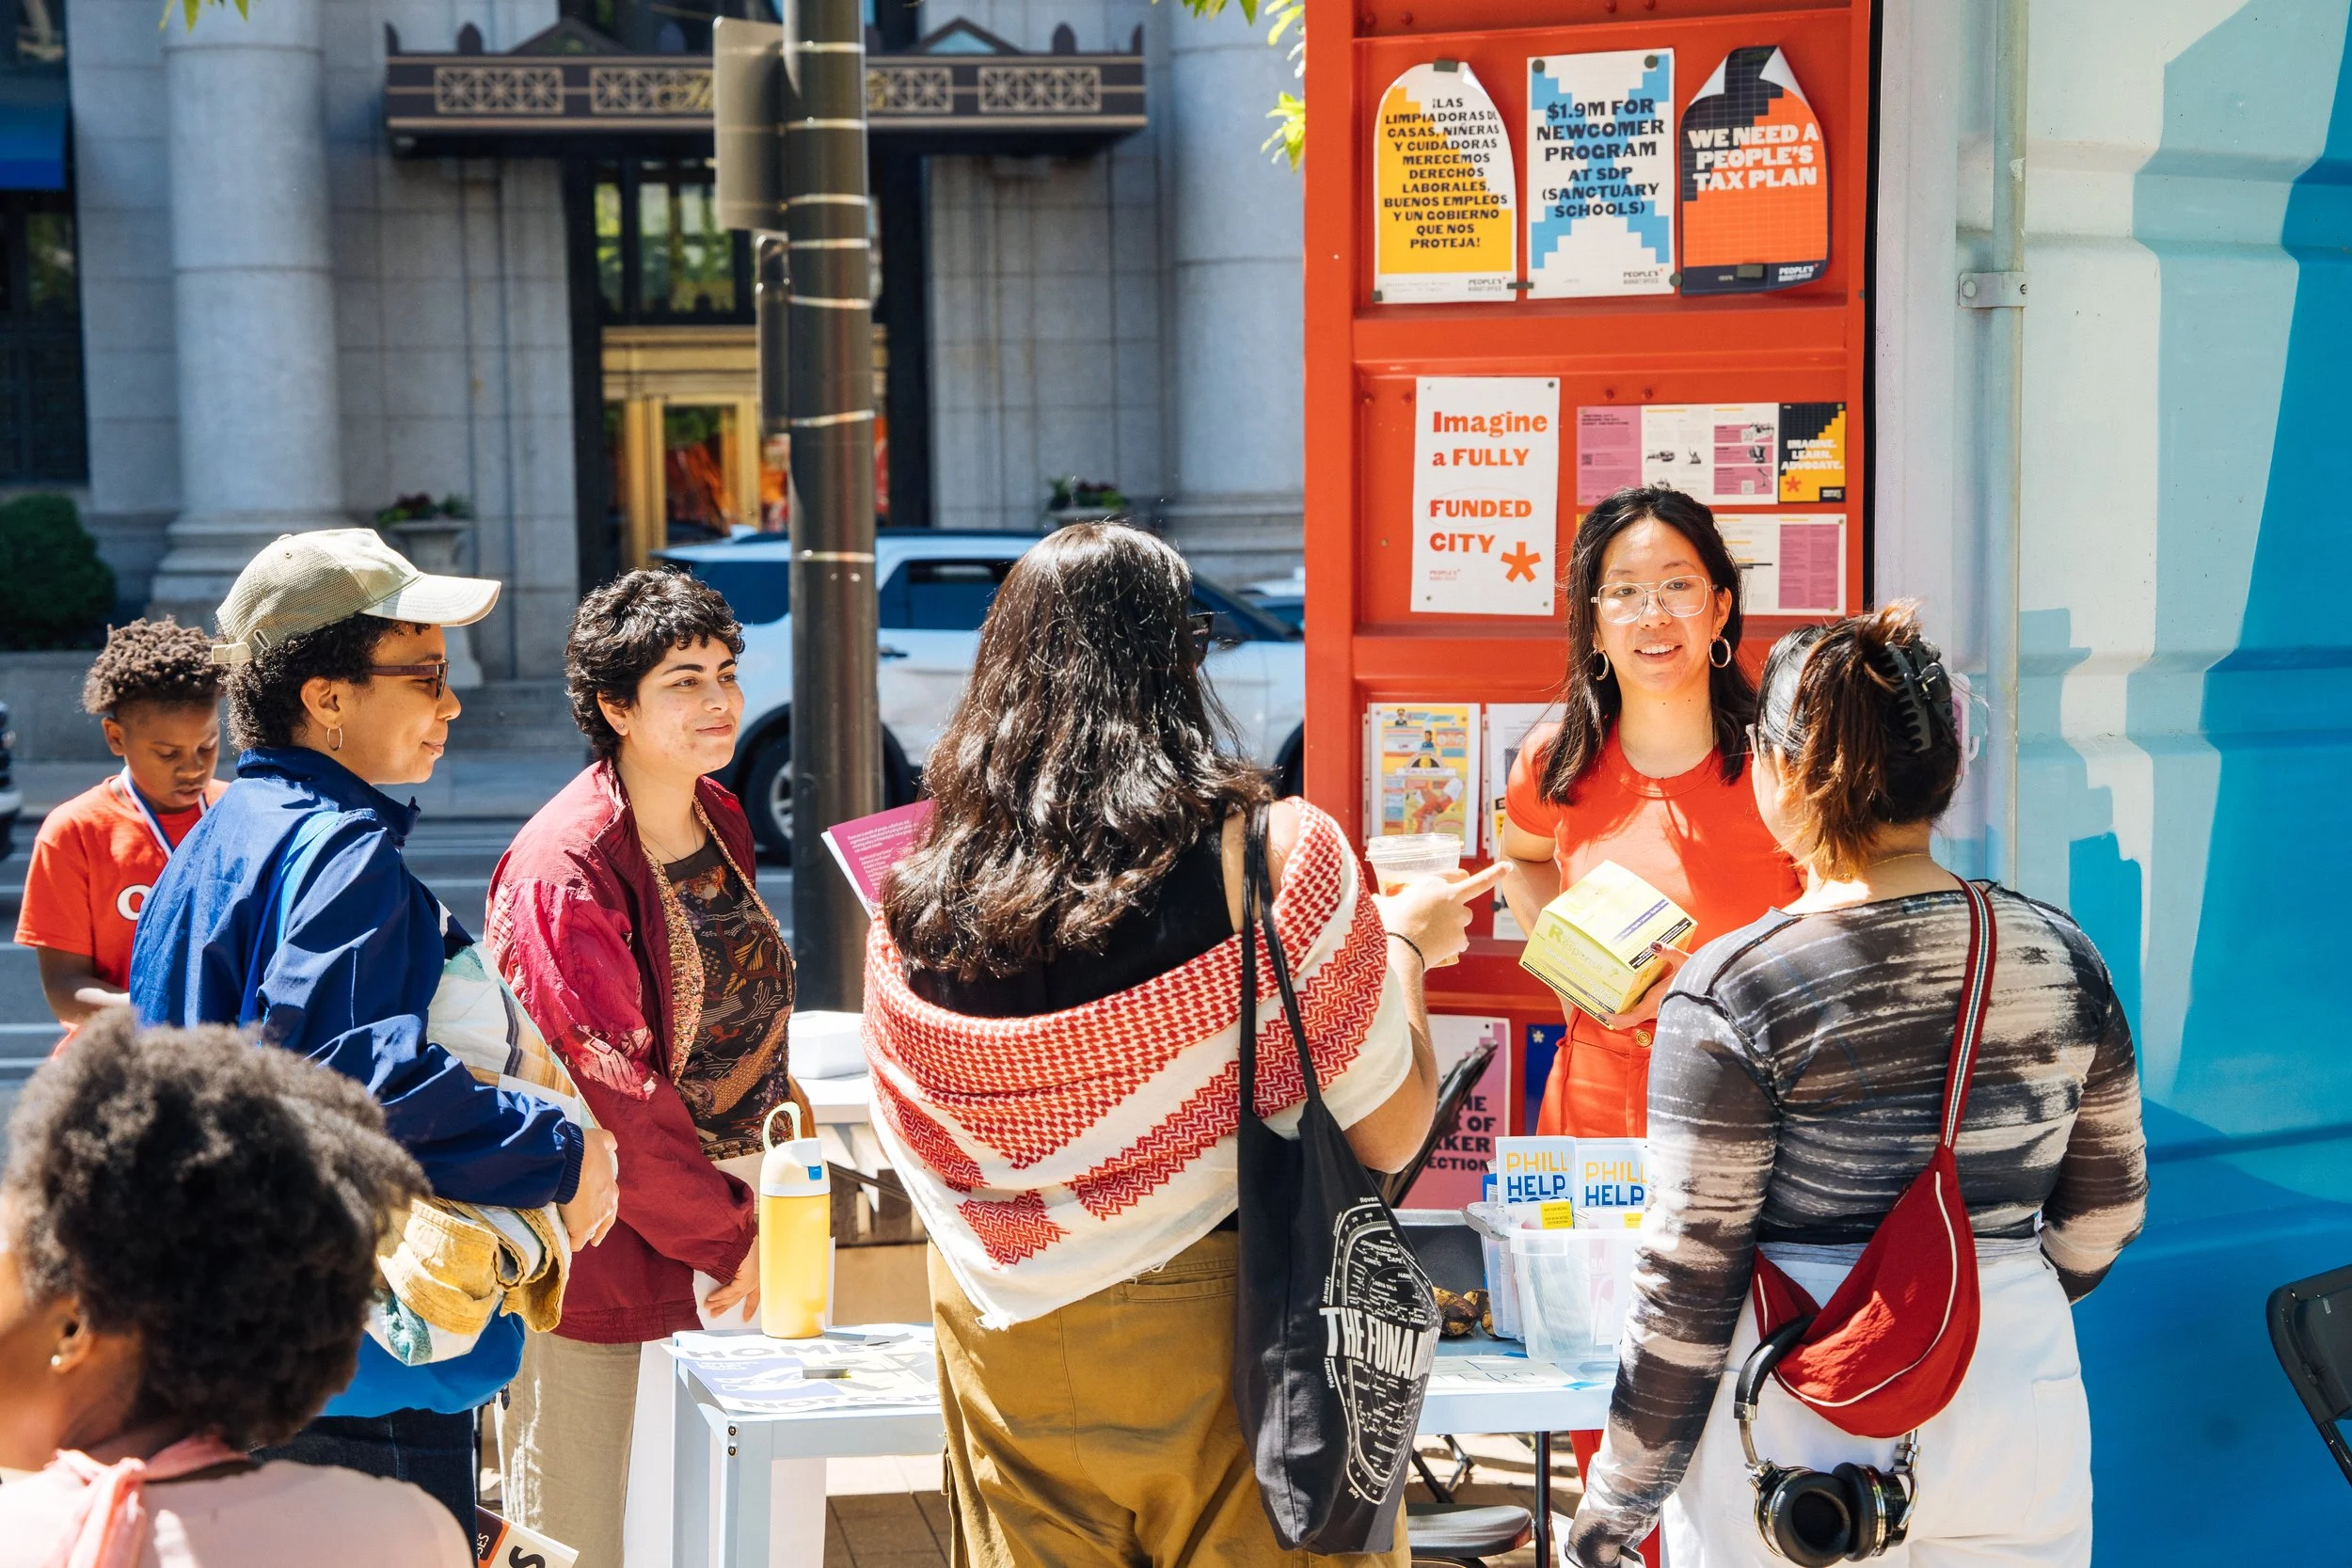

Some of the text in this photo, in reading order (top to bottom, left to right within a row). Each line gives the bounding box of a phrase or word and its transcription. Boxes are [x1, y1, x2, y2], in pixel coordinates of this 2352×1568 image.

[1432, 98, 1464, 108] ¡LAS
[1548, 98, 1654, 120] $1.9M FOR
[1385, 112, 1485, 124] LIMPIADORAS
[1388, 122, 1500, 138] CASAS, NIÑERAS
[1536, 119, 1664, 140] NEWCOMER
[1688, 122, 1820, 149] WE NEED A
[1394, 138, 1498, 151] Y CUIDADORAS
[1545, 141, 1657, 161] PROGRAM
[1403, 152, 1490, 166] MERECEMOS
[1696, 145, 1814, 170] PEOPLE'S
[1409, 167, 1485, 180] DERECHOS
[1568, 166, 1632, 182] AT SDP
[1692, 166, 1817, 192] TAX PLAN
[1402, 182, 1490, 194] LABORALES,
[1542, 182, 1660, 200] (SANCTUARY
[1384, 195, 1508, 208] BUENOS EMPLEOS
[1554, 201, 1645, 218] SCHOOLS)
[1393, 209, 1500, 222] Y UN GOBIERNO
[1417, 224, 1475, 236] QUE NOS
[1410, 237, 1480, 249] PROTEJA!
[1433, 411, 1548, 437] Imagine
[1432, 449, 1530, 467] a FULLY
[1430, 499, 1533, 517] FUNDED
[1430, 532, 1495, 553] CITY
[1466, 1096, 1487, 1112] HE
[1468, 1116, 1497, 1132] OF
[1427, 1156, 1489, 1172] ECTION
[1585, 1161, 1648, 1183] PHILL
[1507, 1175, 1565, 1196] HELP
[1585, 1184, 1645, 1206] HELP
[1322, 1275, 1331, 1304] January
[1319, 1307, 1364, 1360] THE
[1324, 1357, 1336, 1388] February
[849, 1392, 939, 1402] COP
